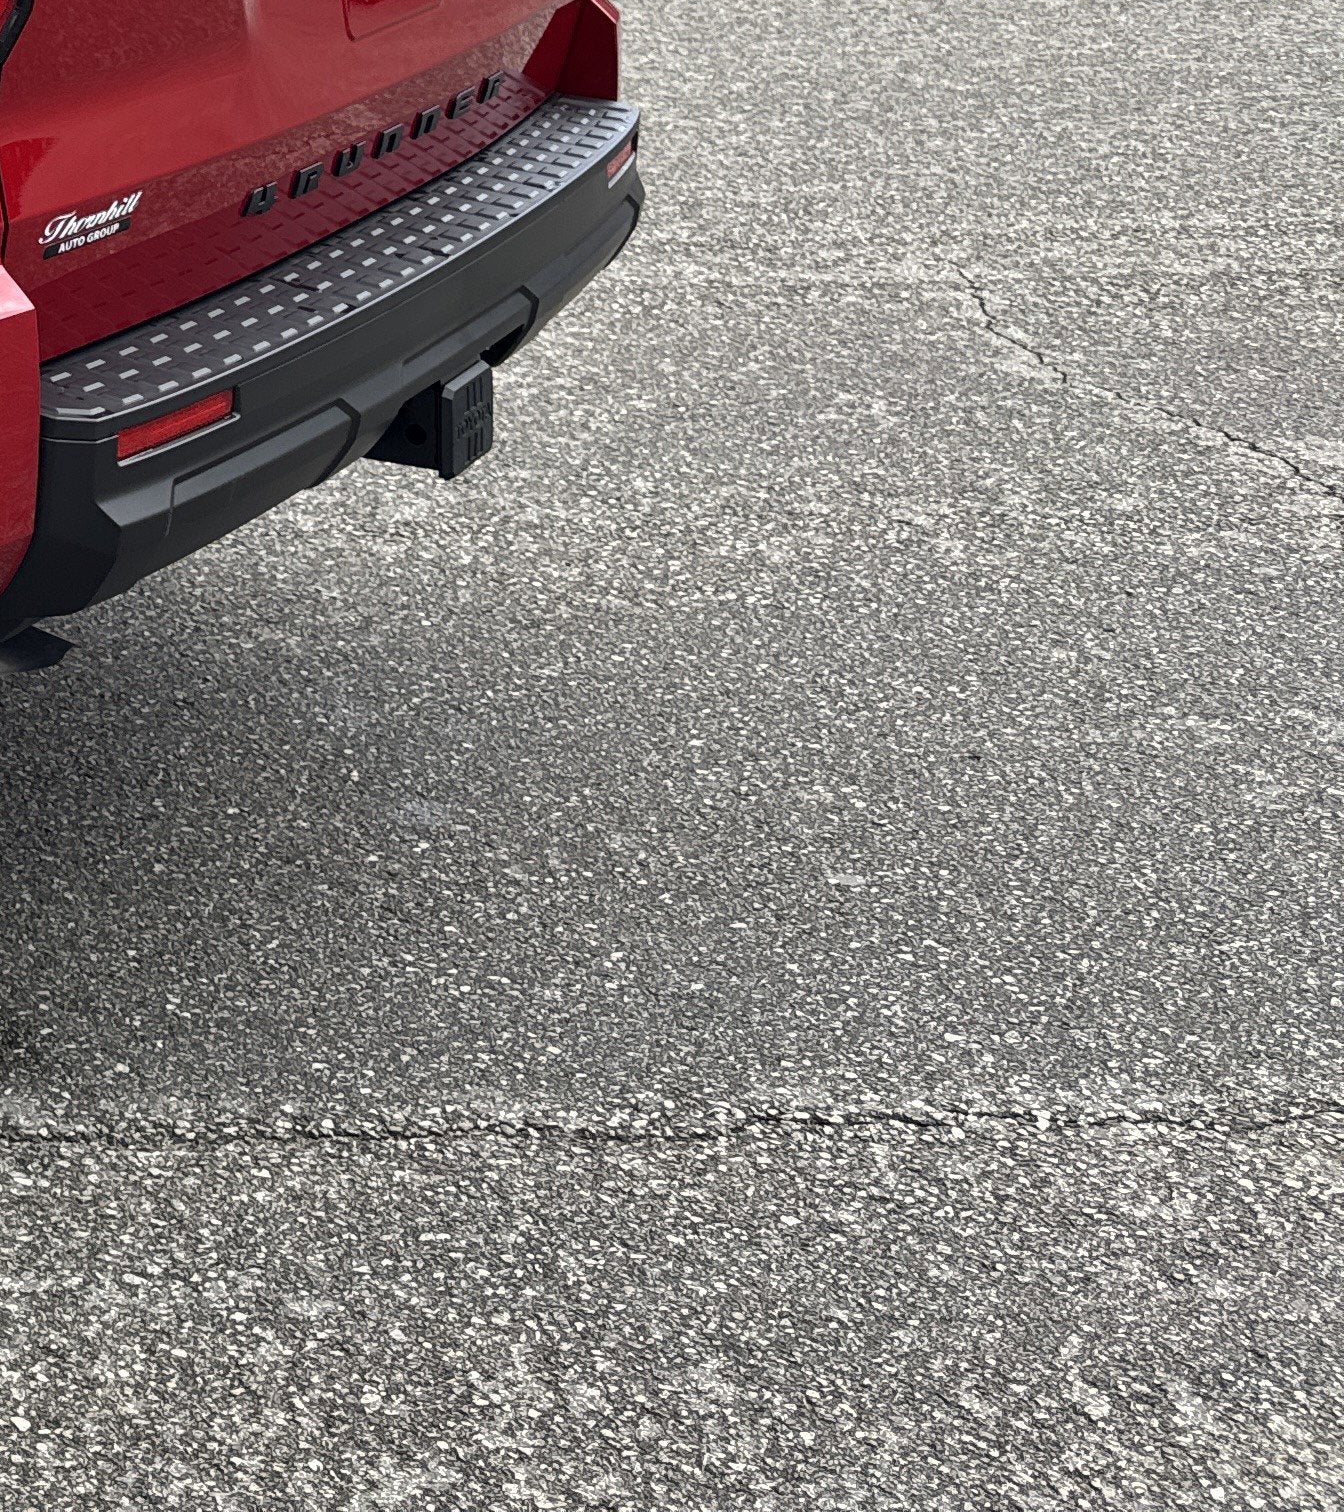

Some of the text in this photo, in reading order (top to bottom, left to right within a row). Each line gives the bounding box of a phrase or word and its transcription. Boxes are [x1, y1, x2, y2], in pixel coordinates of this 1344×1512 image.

[242, 70, 504, 216] 4RUNNER
[38, 190, 143, 245] Thornhill
[58, 223, 120, 254] AUTO GROUP
